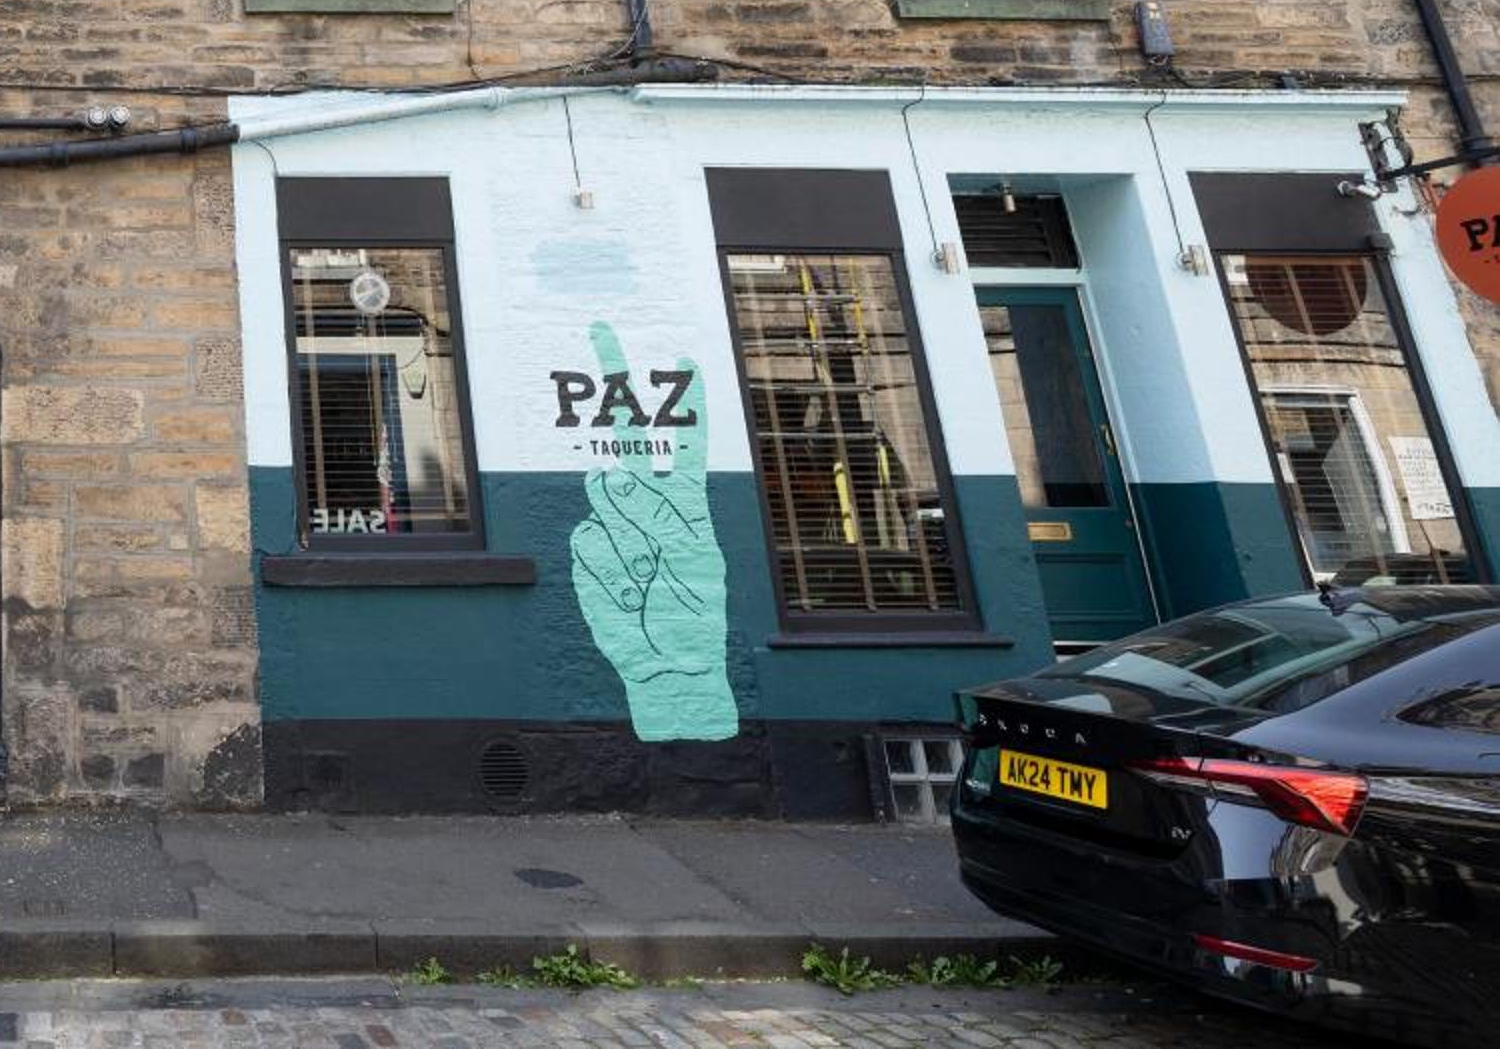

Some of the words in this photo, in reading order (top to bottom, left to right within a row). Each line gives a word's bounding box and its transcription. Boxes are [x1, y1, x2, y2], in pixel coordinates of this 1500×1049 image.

[550, 369, 697, 427] PAZ
[590, 440, 672, 458] TAQUERIA
[1007, 756, 1051, 790] AK24
[1056, 766, 1097, 800] TMY
